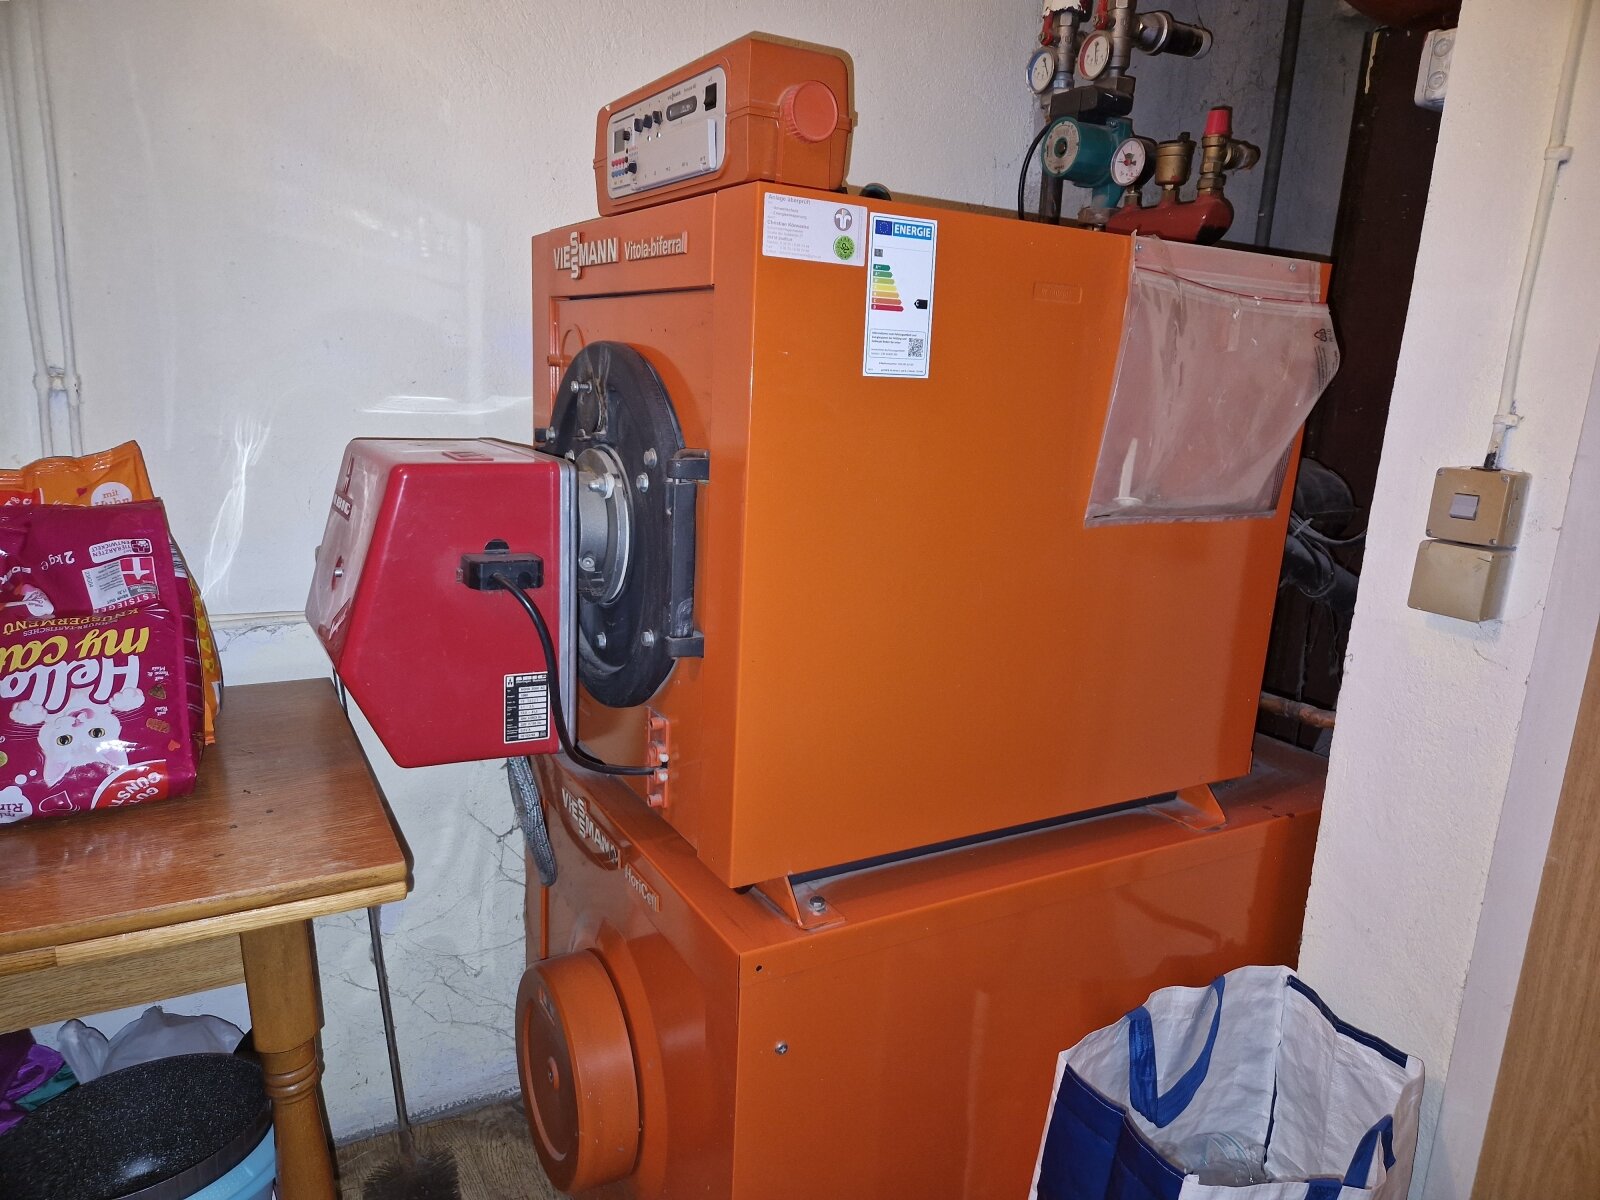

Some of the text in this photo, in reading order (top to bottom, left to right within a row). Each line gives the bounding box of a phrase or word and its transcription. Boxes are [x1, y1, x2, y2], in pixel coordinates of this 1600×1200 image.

[894, 224, 932, 238] ENERGIE
[553, 231, 688, 279] VIESSMANN Vitola-biferral
[103, 488, 119, 499] mit
[48, 553, 63, 567] kg
[63, 550, 75, 564] 2
[75, 626, 150, 659] my
[0, 655, 140, 713] Hello
[624, 863, 660, 912] HoriCell
